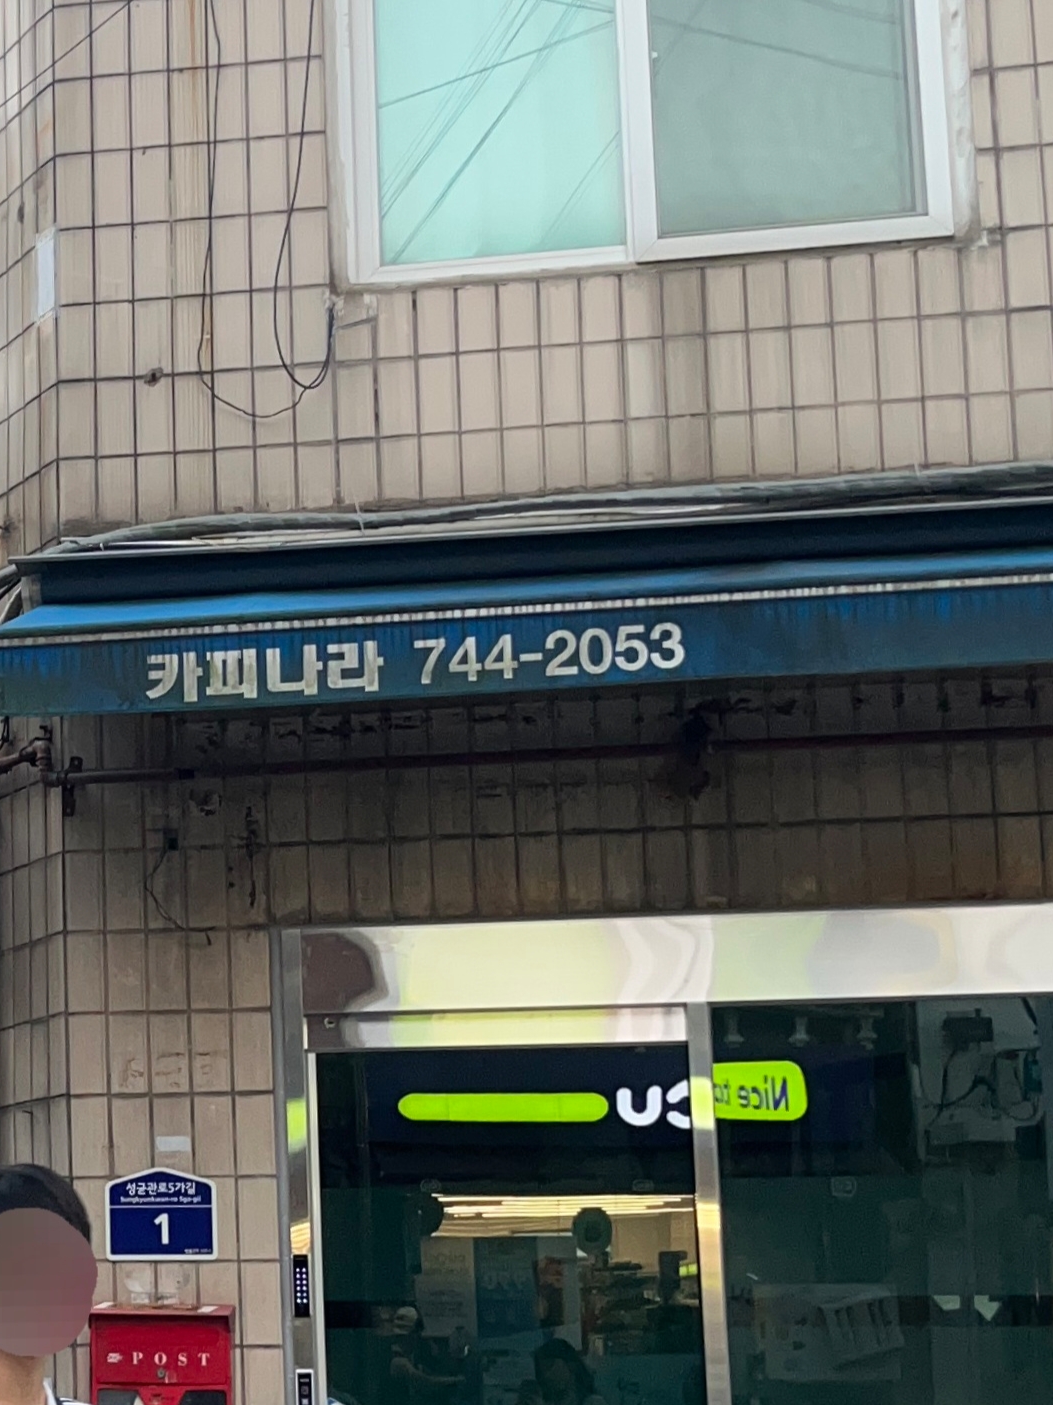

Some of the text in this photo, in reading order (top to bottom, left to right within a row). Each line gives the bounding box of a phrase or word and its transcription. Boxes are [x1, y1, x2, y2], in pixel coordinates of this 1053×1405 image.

[146, 621, 686, 703] 카피나라 744-2053
[126, 1181, 196, 1196] 성균관로5가길
[153, 1212, 170, 1246] 1
[132, 1351, 210, 1367] POST
